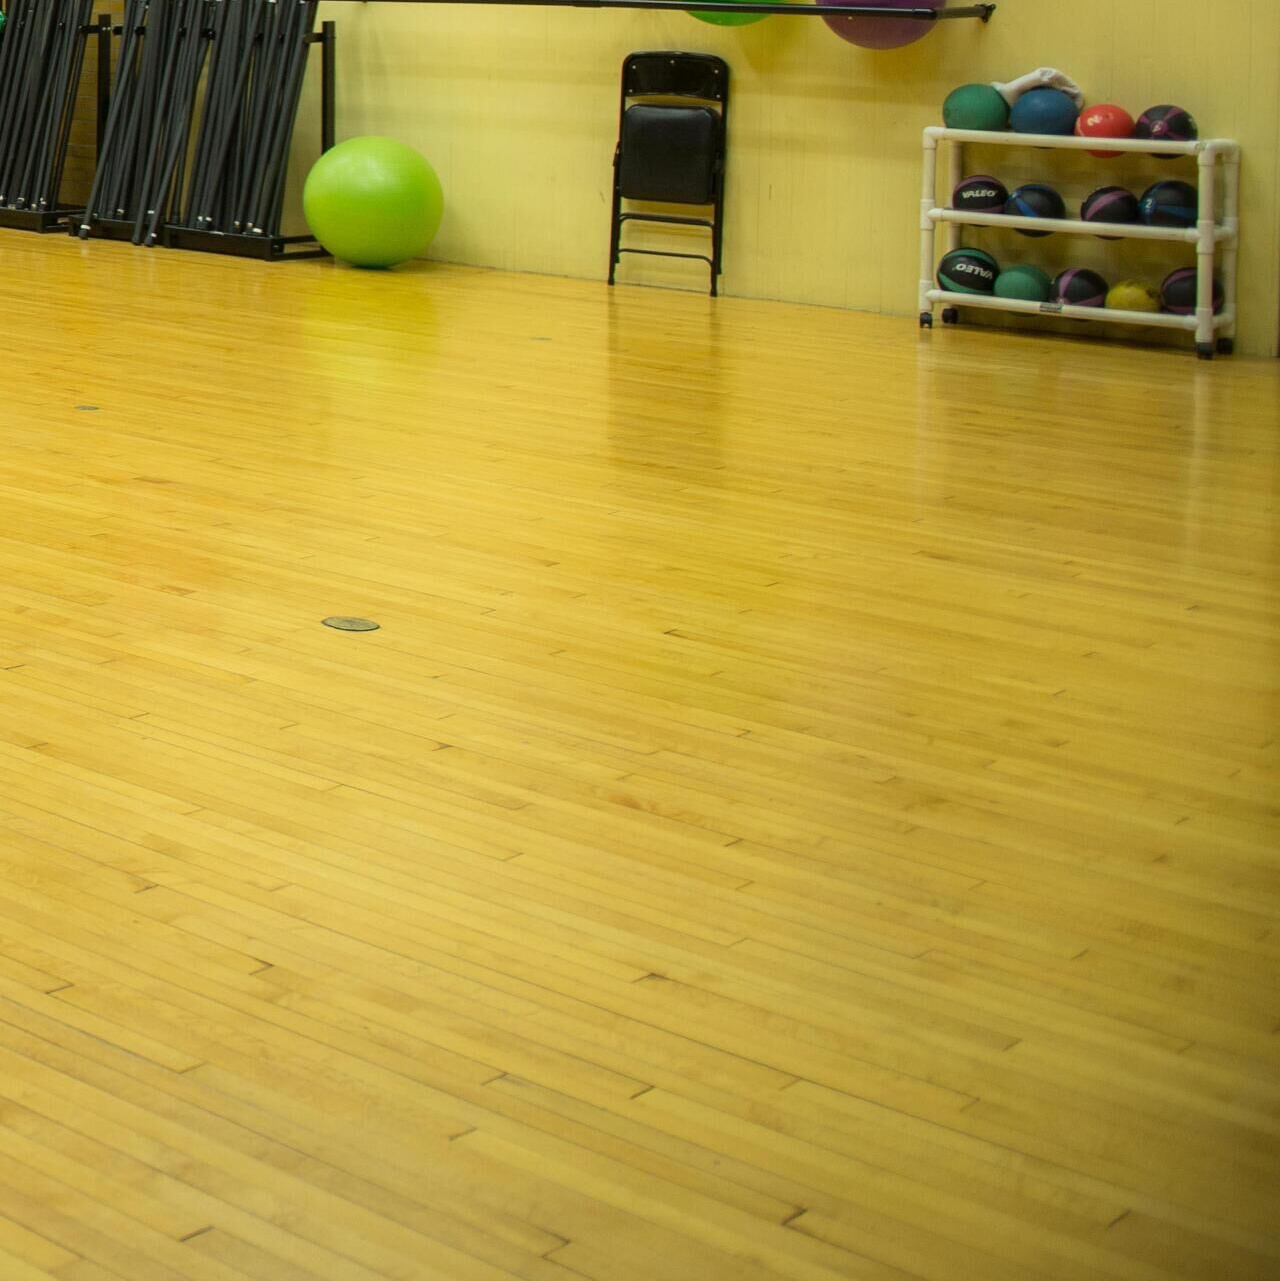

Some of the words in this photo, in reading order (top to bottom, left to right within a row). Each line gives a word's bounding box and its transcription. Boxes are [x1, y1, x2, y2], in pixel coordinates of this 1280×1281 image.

[962, 189, 996, 199] VALEO
[1145, 199, 1153, 208] 2
[955, 263, 993, 279] VALEO
